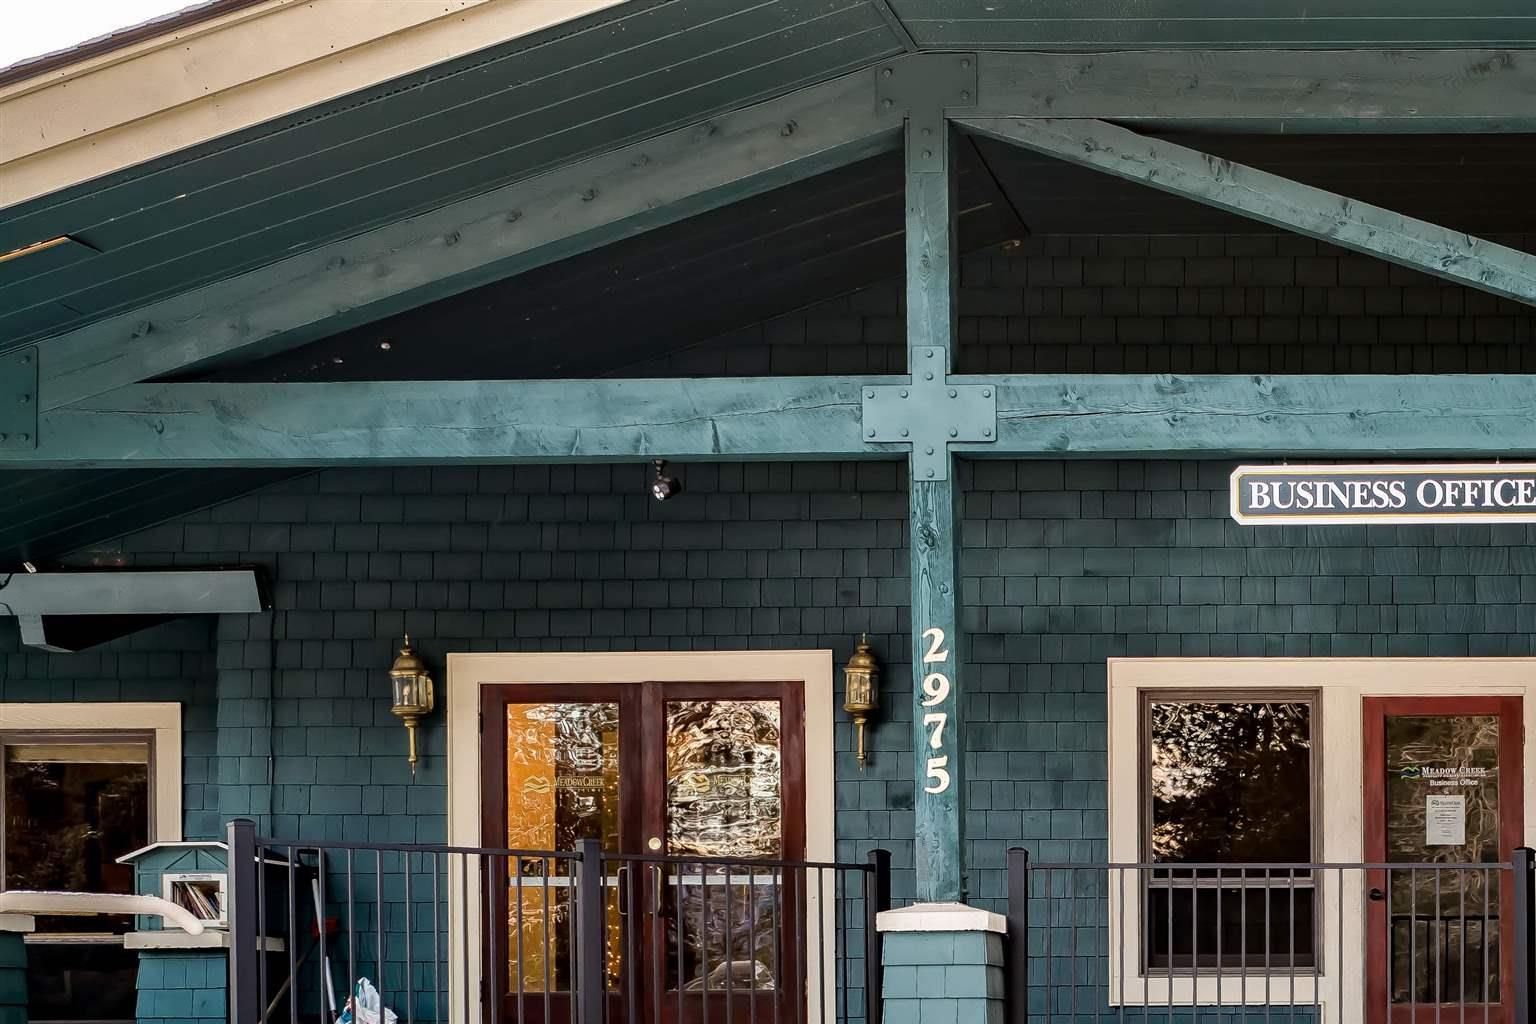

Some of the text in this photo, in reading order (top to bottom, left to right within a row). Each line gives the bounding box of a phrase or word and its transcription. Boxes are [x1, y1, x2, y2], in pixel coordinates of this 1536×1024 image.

[1248, 479, 1536, 509] BUSINESS OFFICE
[922, 627, 950, 794] 2975
